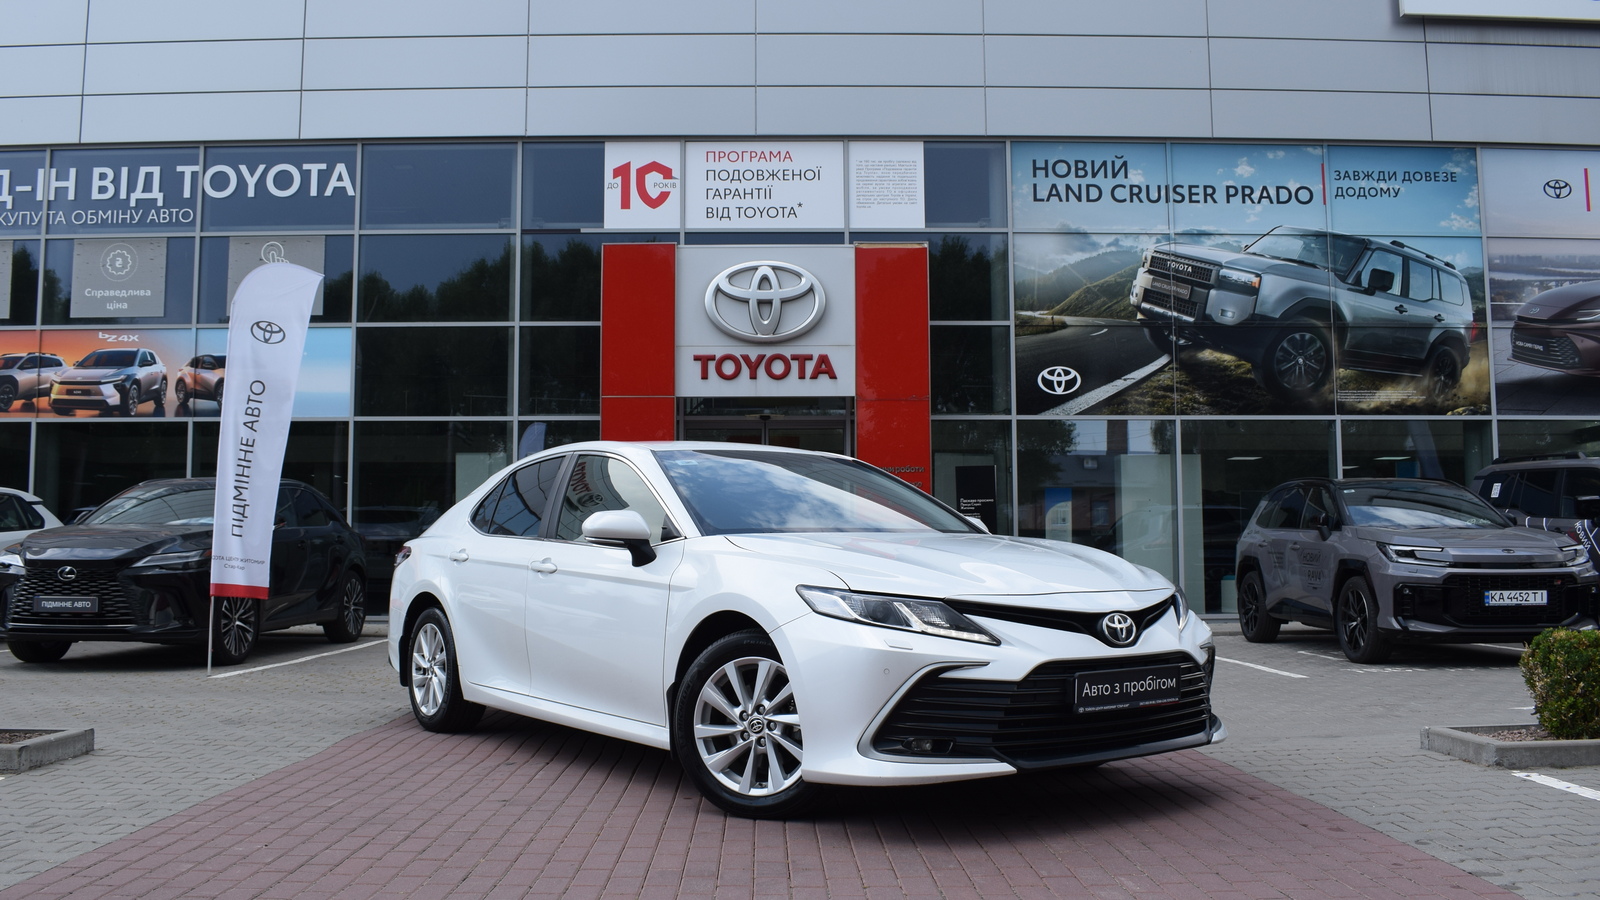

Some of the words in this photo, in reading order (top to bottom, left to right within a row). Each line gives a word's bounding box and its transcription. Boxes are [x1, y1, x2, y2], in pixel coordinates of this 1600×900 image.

[705, 150, 793, 163] ПРОГРАМА
[705, 165, 822, 184] ПОДОВЖЕНОЇ
[1032, 155, 1129, 179] НОВИЙ
[91, 165, 164, 208] ВІД
[176, 162, 356, 199] TOYOTA
[1333, 170, 1398, 183] ЗАВЖДИ
[1401, 171, 1459, 184] ДОВЕЗЕ
[607, 182, 619, 190] ДО
[705, 184, 773, 200] ГАРАНТІЇ
[1032, 183, 1103, 203] LAND
[1110, 184, 1217, 204] CRUISER
[1226, 185, 1315, 205] PRADO
[1334, 186, 1401, 200] ДОДОМУ
[47, 210, 66, 225] ТА
[71, 208, 143, 225] ОБМІНУ
[147, 207, 194, 223] АВТО
[705, 206, 732, 222] ВІД
[1166, 261, 1192, 273] TOYOTA
[84, 288, 152, 299] Справедлива
[106, 301, 129, 312] ціна
[693, 353, 838, 381] TOYOTA
[243, 379, 266, 433] АВТО
[895, 465, 924, 474] роботи
[231, 436, 256, 538] ПІДМІННЕ
[1574, 520, 1592, 551] НОВИЙ
[1303, 552, 1321, 563] НОВИЙ
[1308, 569, 1321, 581] RAV4
[1081, 682, 1110, 697] Авто
[1113, 683, 1120, 695] з
[1123, 675, 1176, 696] пробігом
